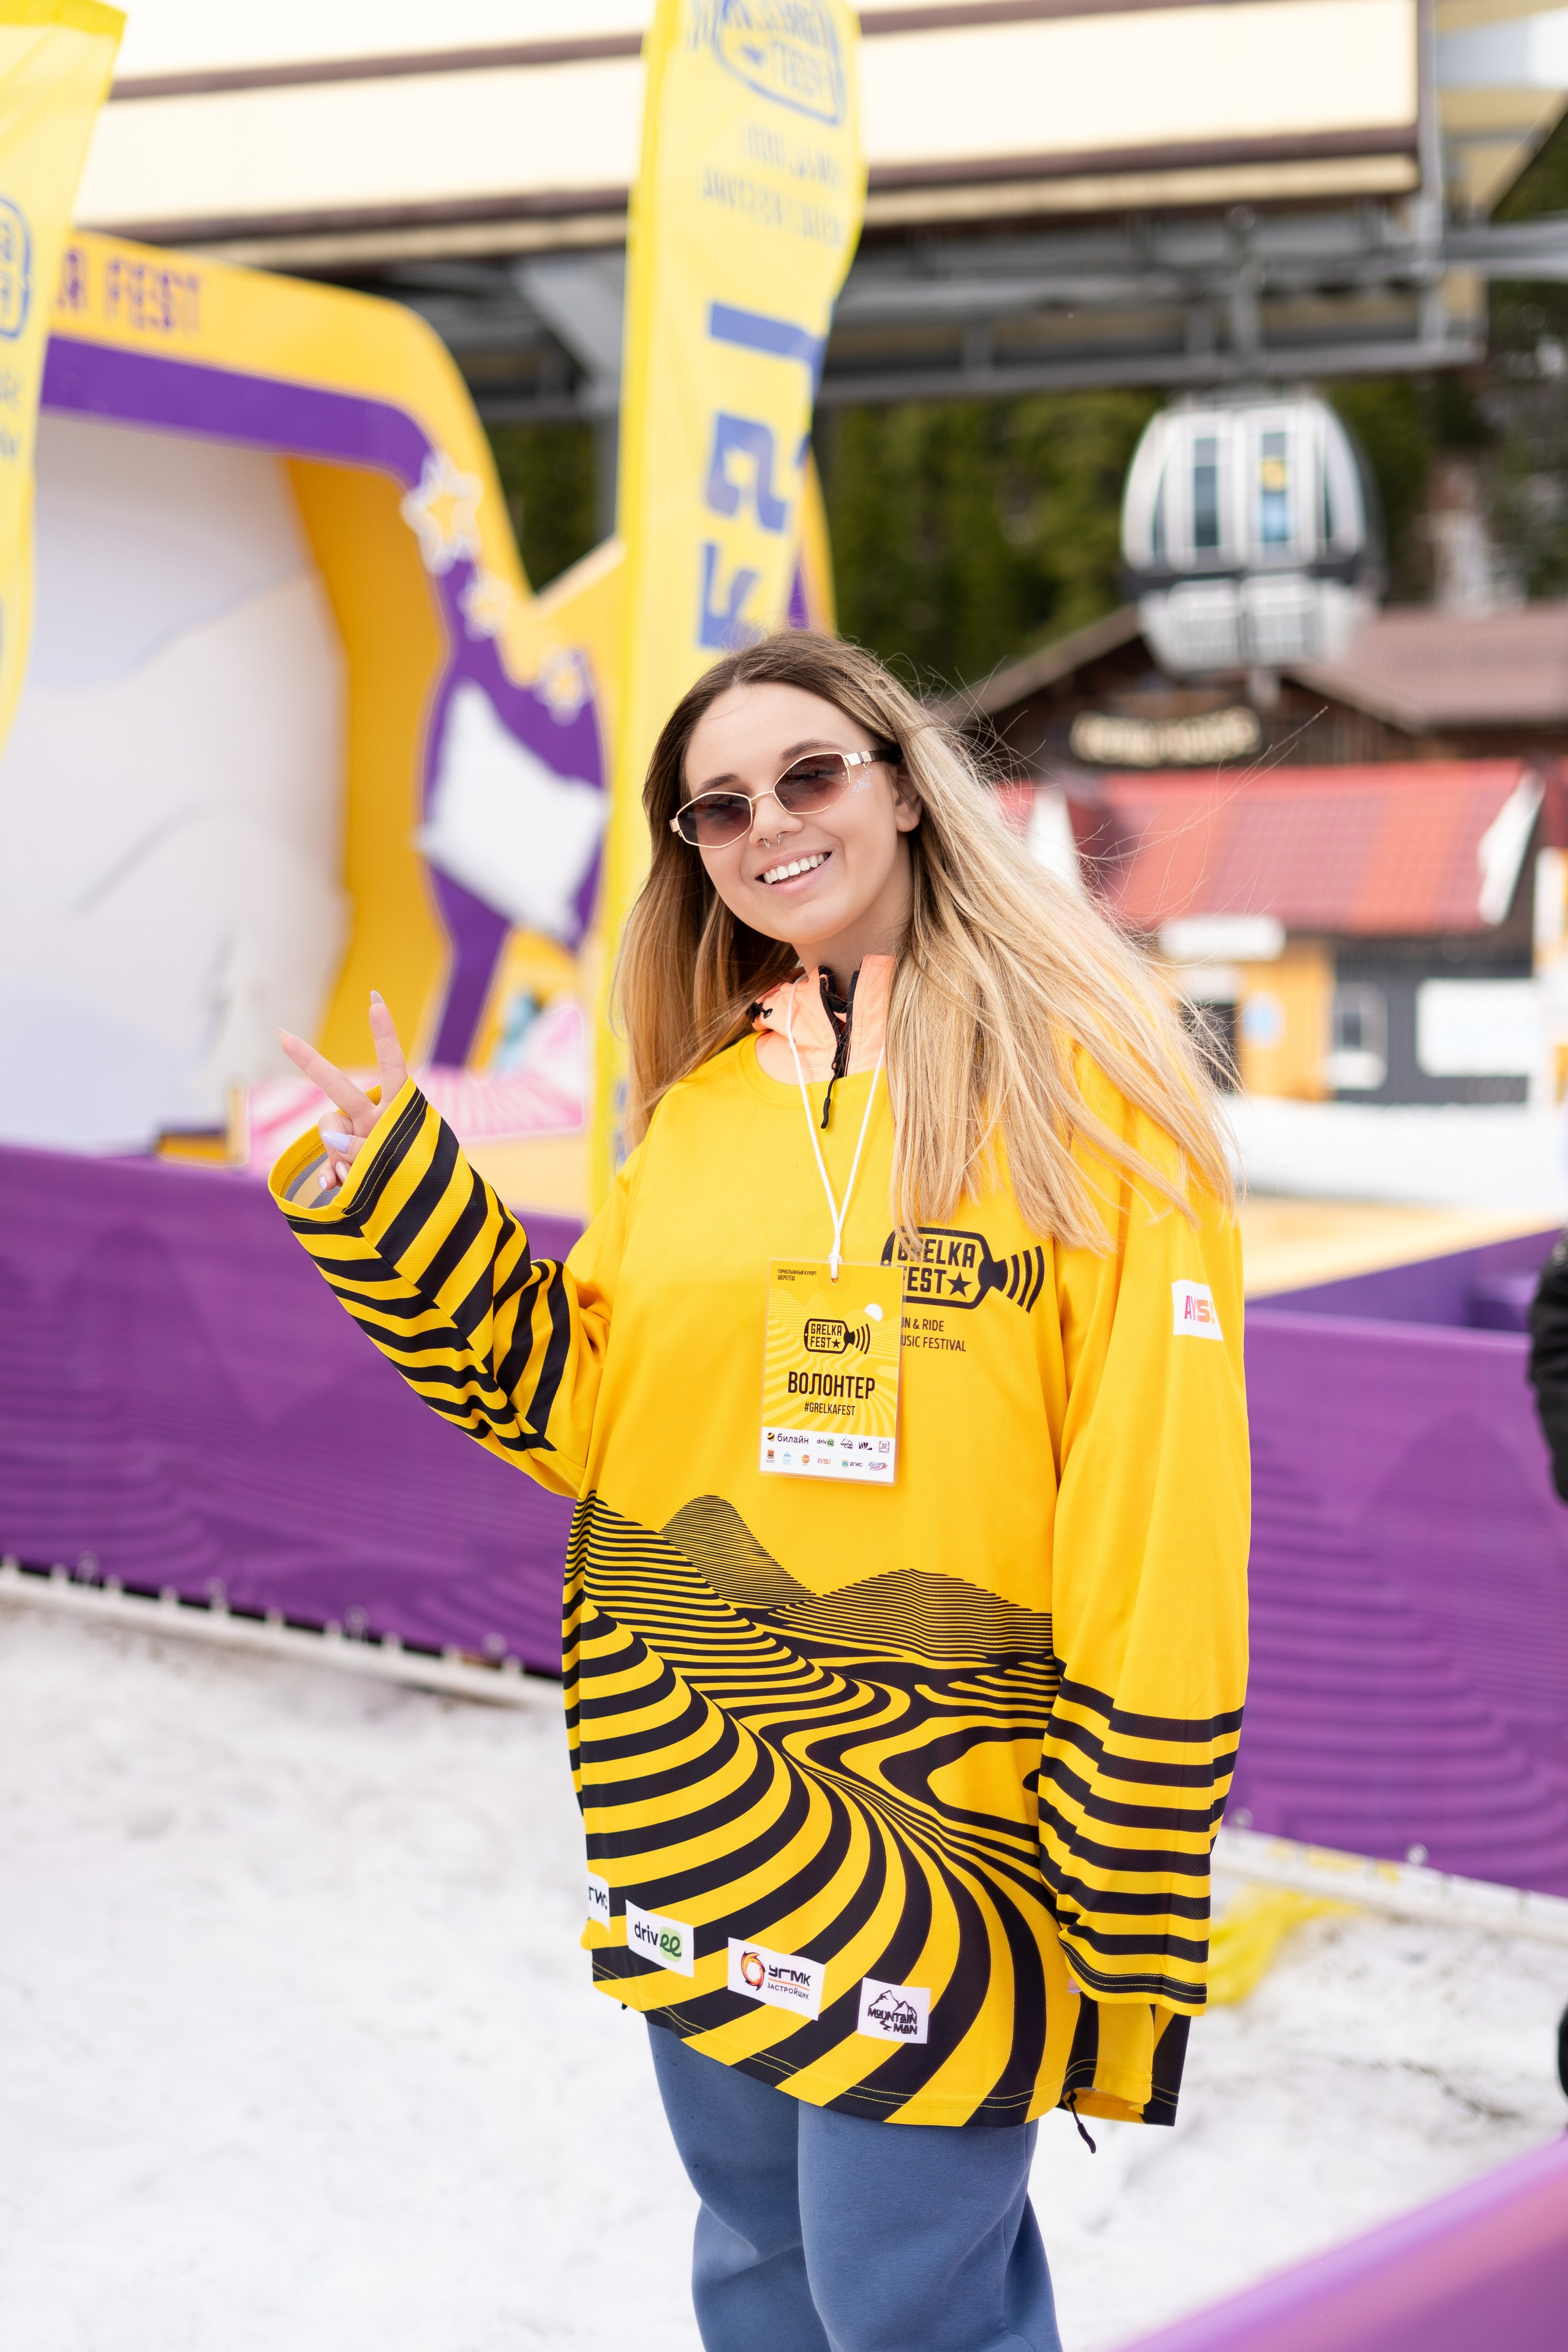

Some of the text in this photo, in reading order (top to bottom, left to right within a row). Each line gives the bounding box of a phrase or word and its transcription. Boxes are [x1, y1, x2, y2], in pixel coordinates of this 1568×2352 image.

[1184, 1295, 1216, 1324] AYS!
[811, 1323, 842, 1336] GRELKA
[913, 1318, 920, 1329] &
[922, 1319, 944, 1332] RIDE
[810, 1336, 832, 1348] FEST
[901, 1334, 967, 1352] USIC FESTIVAL
[788, 1371, 876, 1400] ВОЛОНТЕР
[804, 1401, 856, 1415] #GRELKAFEST
[777, 1433, 809, 1444] билайн
[588, 1885, 608, 1910] ГИС
[634, 1921, 682, 1958] drivee
[768, 1964, 812, 1987] УГМК
[767, 1982, 810, 2000] ЗАСТРОЙЩИК
[867, 2006, 918, 2025] MOUNTAIN
[893, 2023, 918, 2035] MAN
